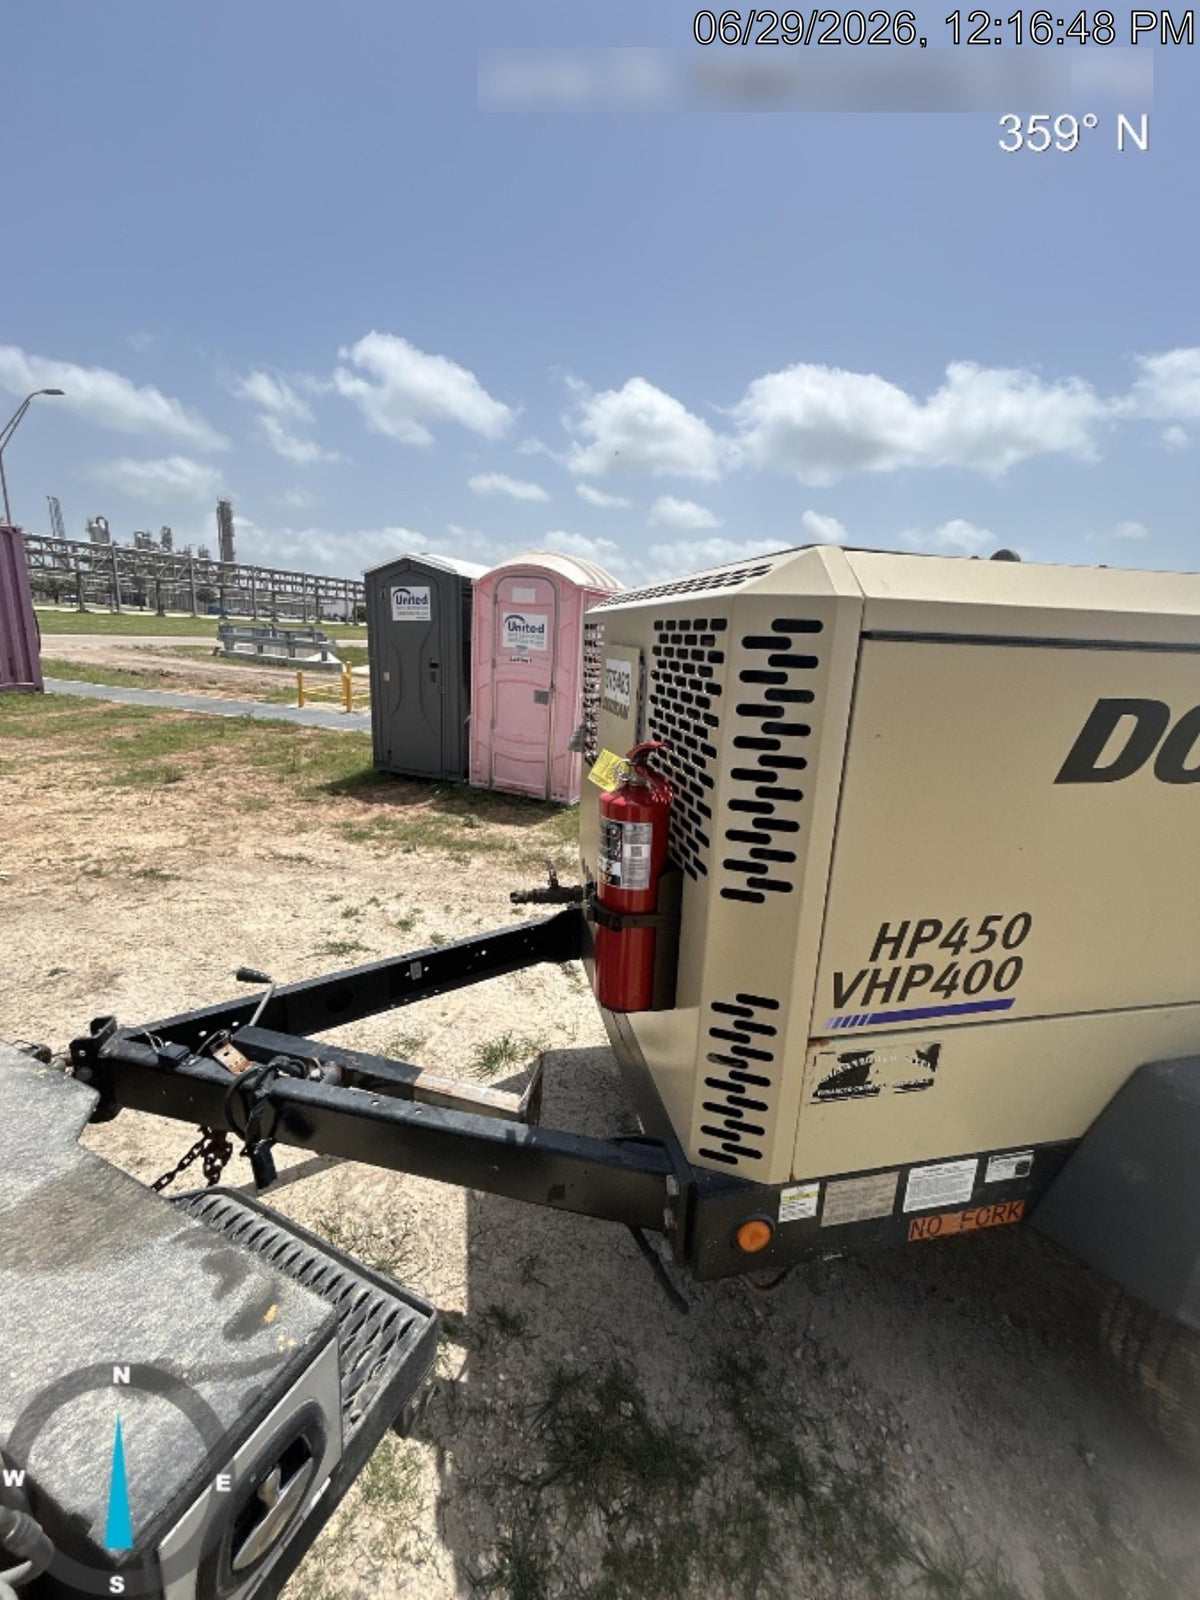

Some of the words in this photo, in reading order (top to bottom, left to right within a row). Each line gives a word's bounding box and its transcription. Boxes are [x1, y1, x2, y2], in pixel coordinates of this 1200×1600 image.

[396, 593, 429, 605] United
[507, 620, 545, 633] United
[868, 911, 1032, 963] HP450
[832, 955, 1024, 1009] VHP400
[910, 1216, 942, 1240] NO
[960, 1201, 1021, 1230] FORK
